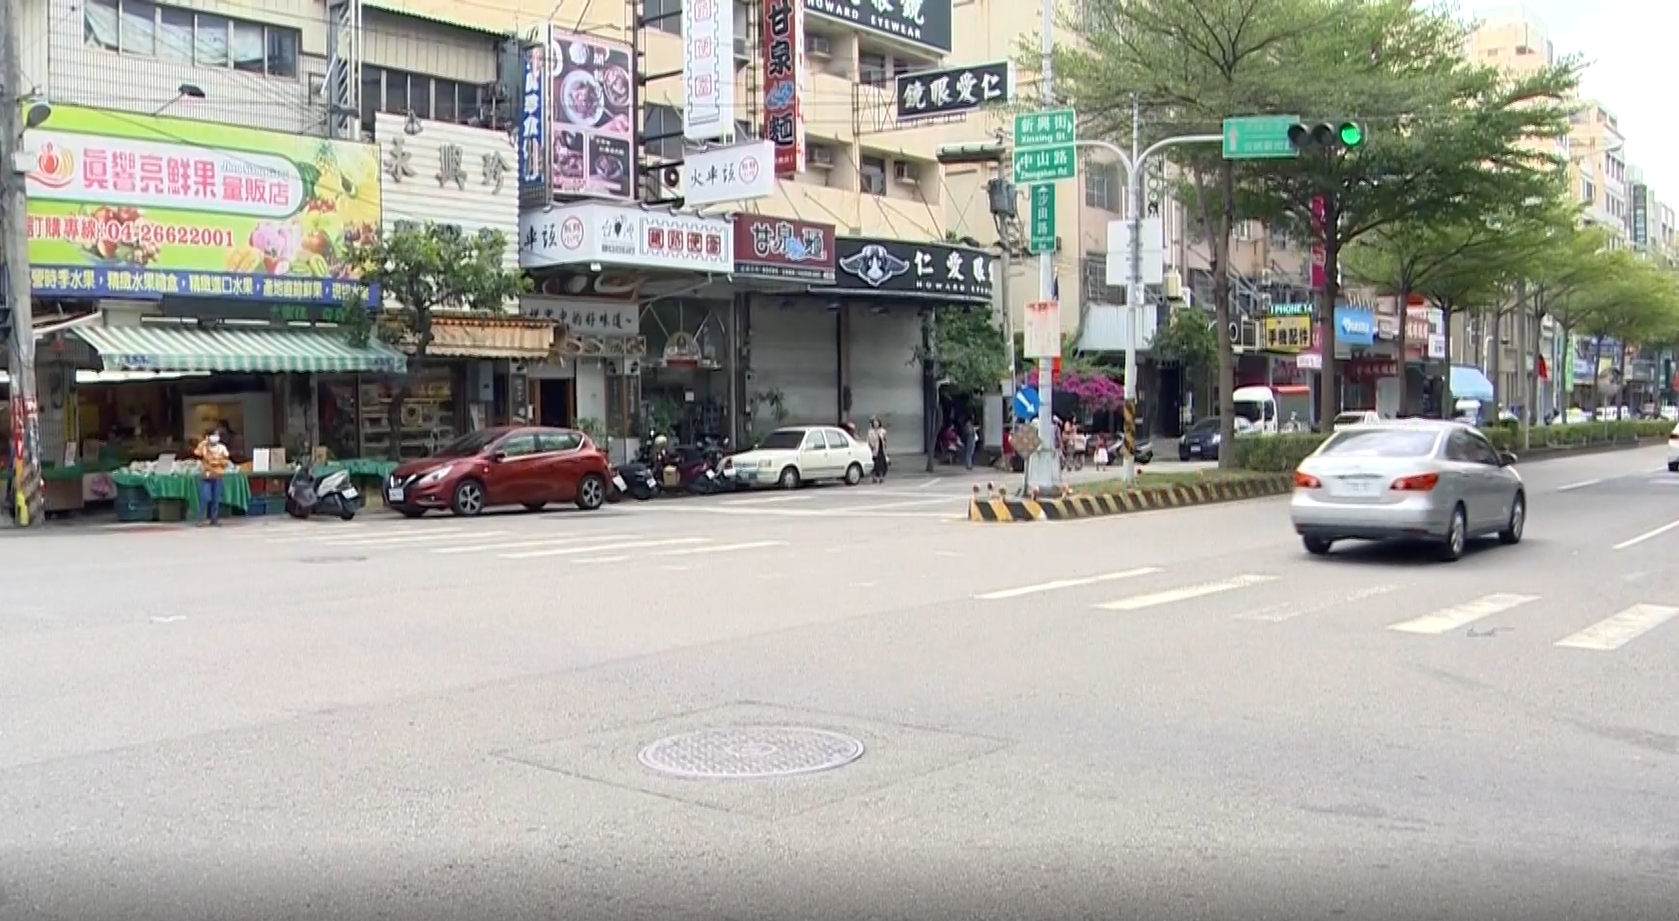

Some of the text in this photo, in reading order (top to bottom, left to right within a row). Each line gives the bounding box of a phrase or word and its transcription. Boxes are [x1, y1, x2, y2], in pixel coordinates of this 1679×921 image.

[870, 15, 921, 39] EYEWEAR
[1021, 115, 1067, 133] 新興街
[1020, 149, 1067, 169] 中山路
[914, 250, 992, 283] 仁愛眼
